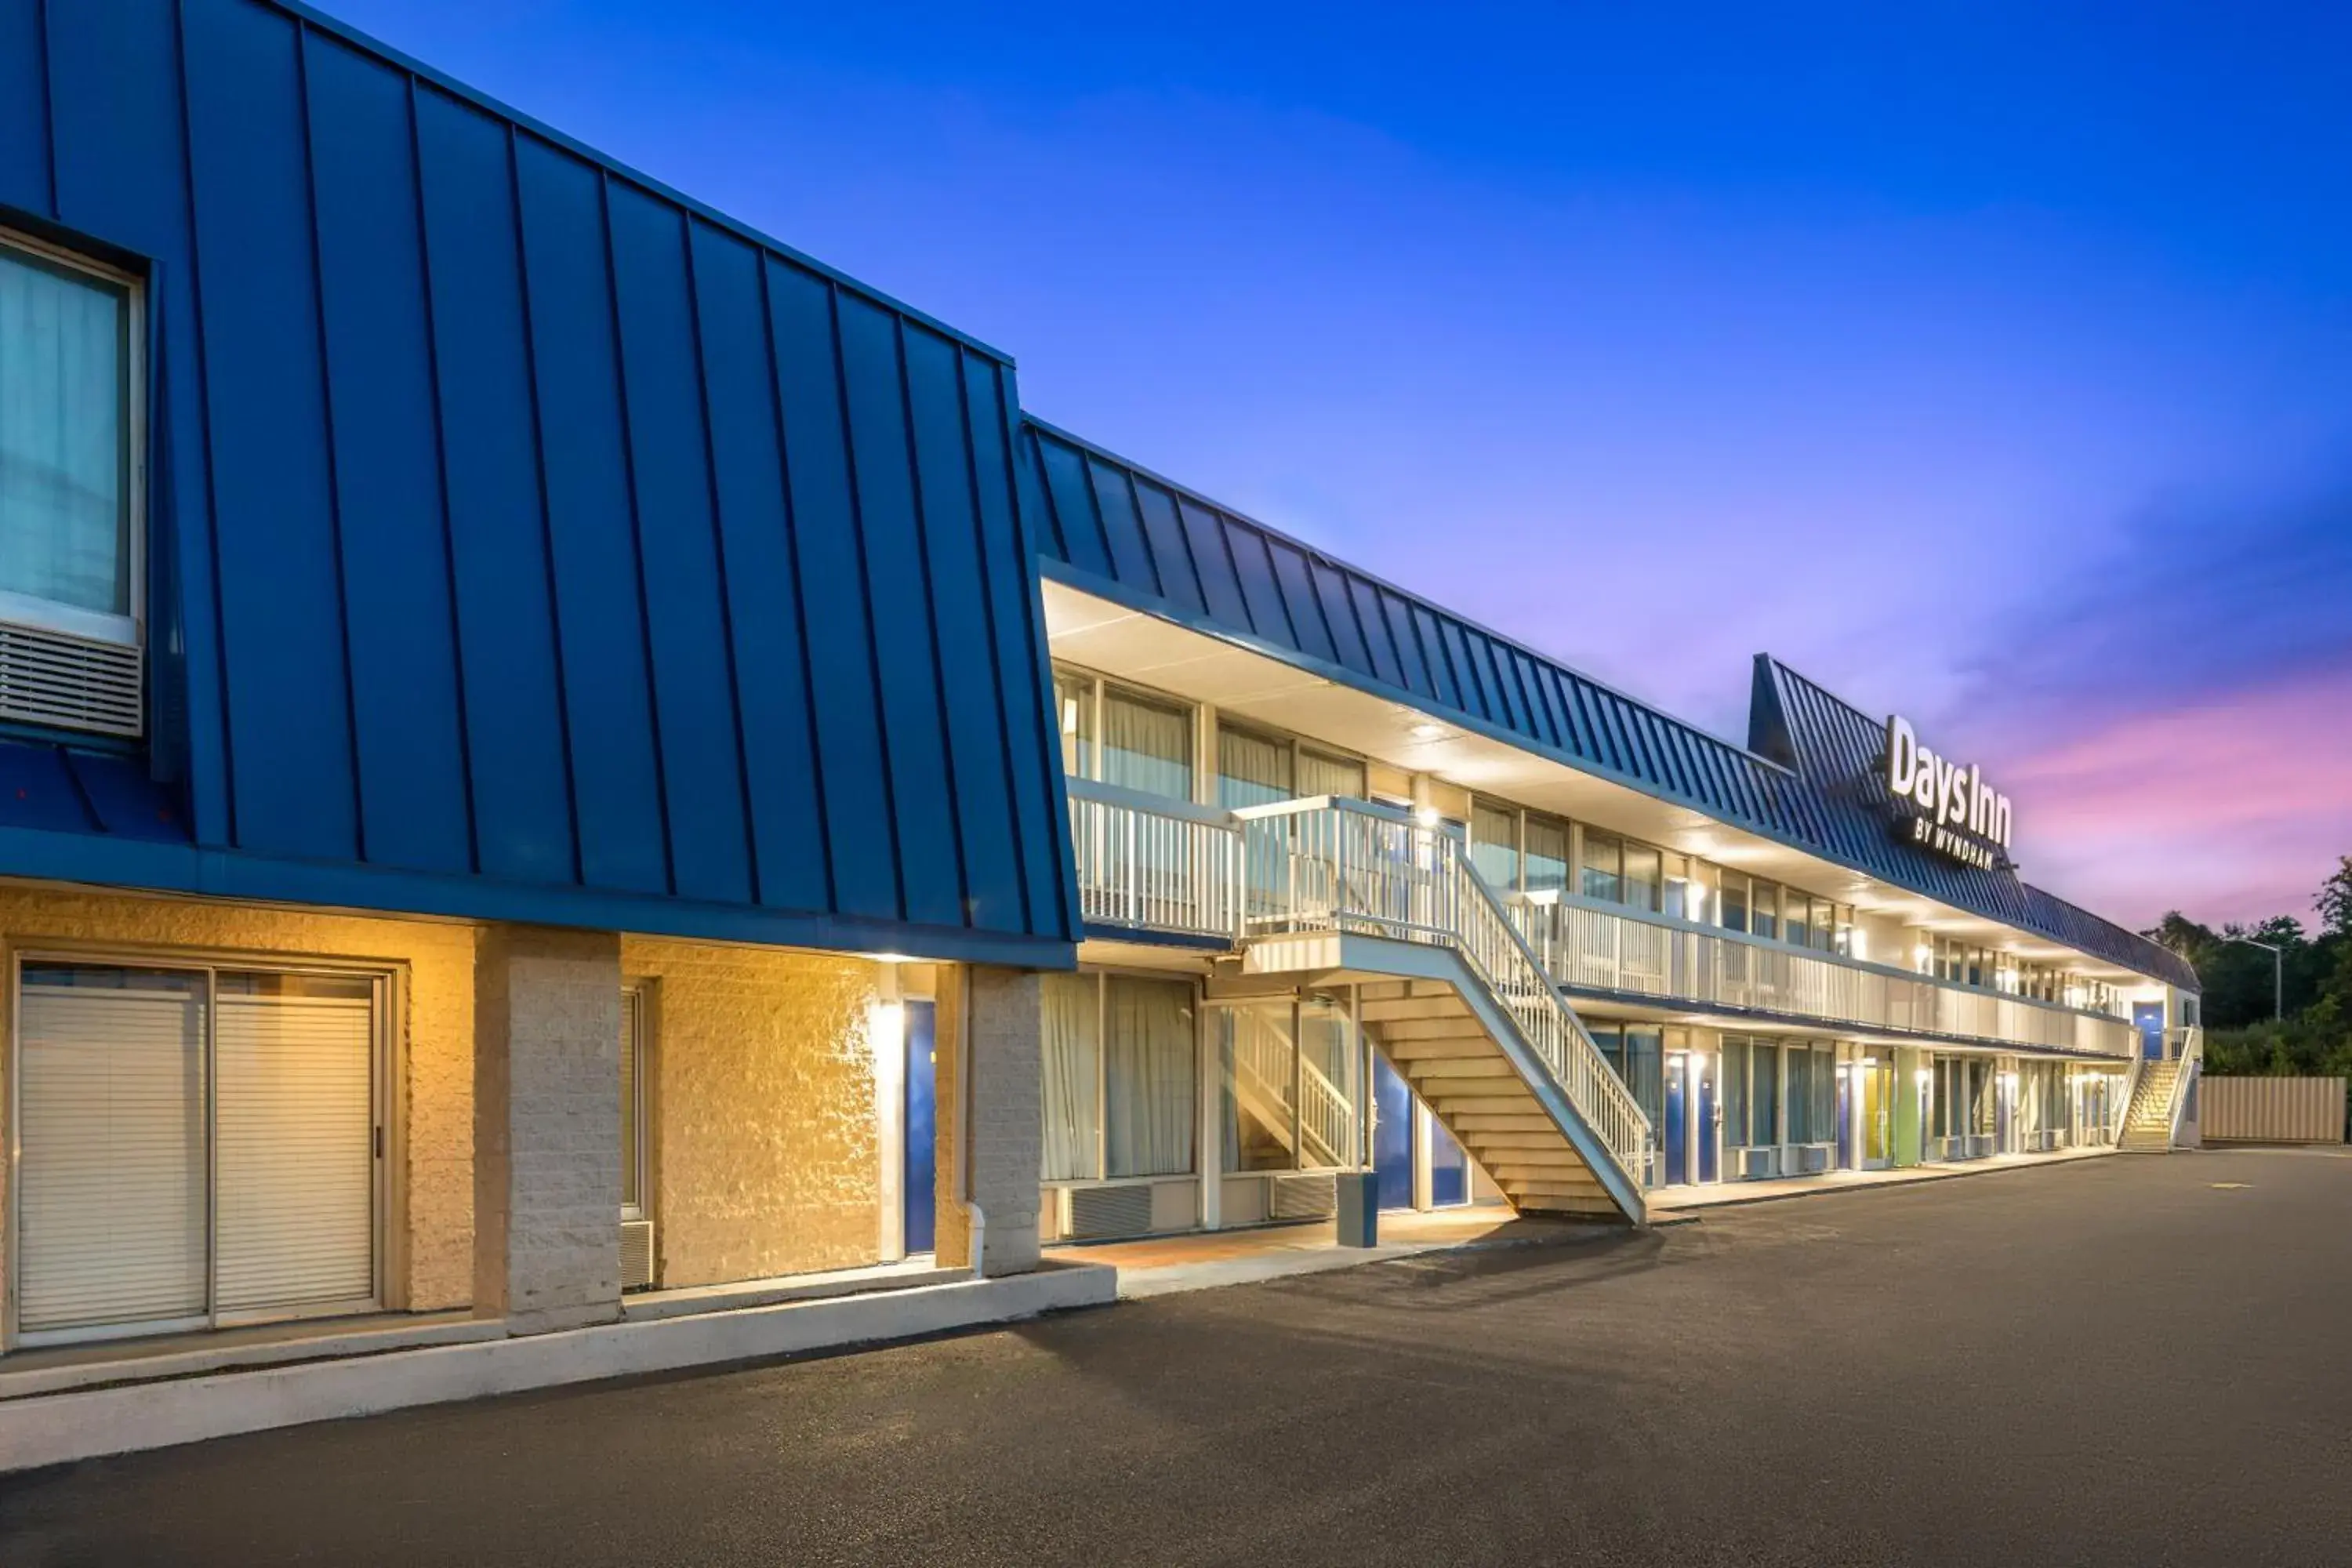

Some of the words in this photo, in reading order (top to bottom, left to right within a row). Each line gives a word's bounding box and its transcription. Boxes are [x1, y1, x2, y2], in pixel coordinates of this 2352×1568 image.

[1890, 714, 1968, 825] Days
[1969, 764, 2012, 848] Inn
[1915, 816, 1933, 843] BY
[1936, 827, 1993, 871] WYNDHAM
